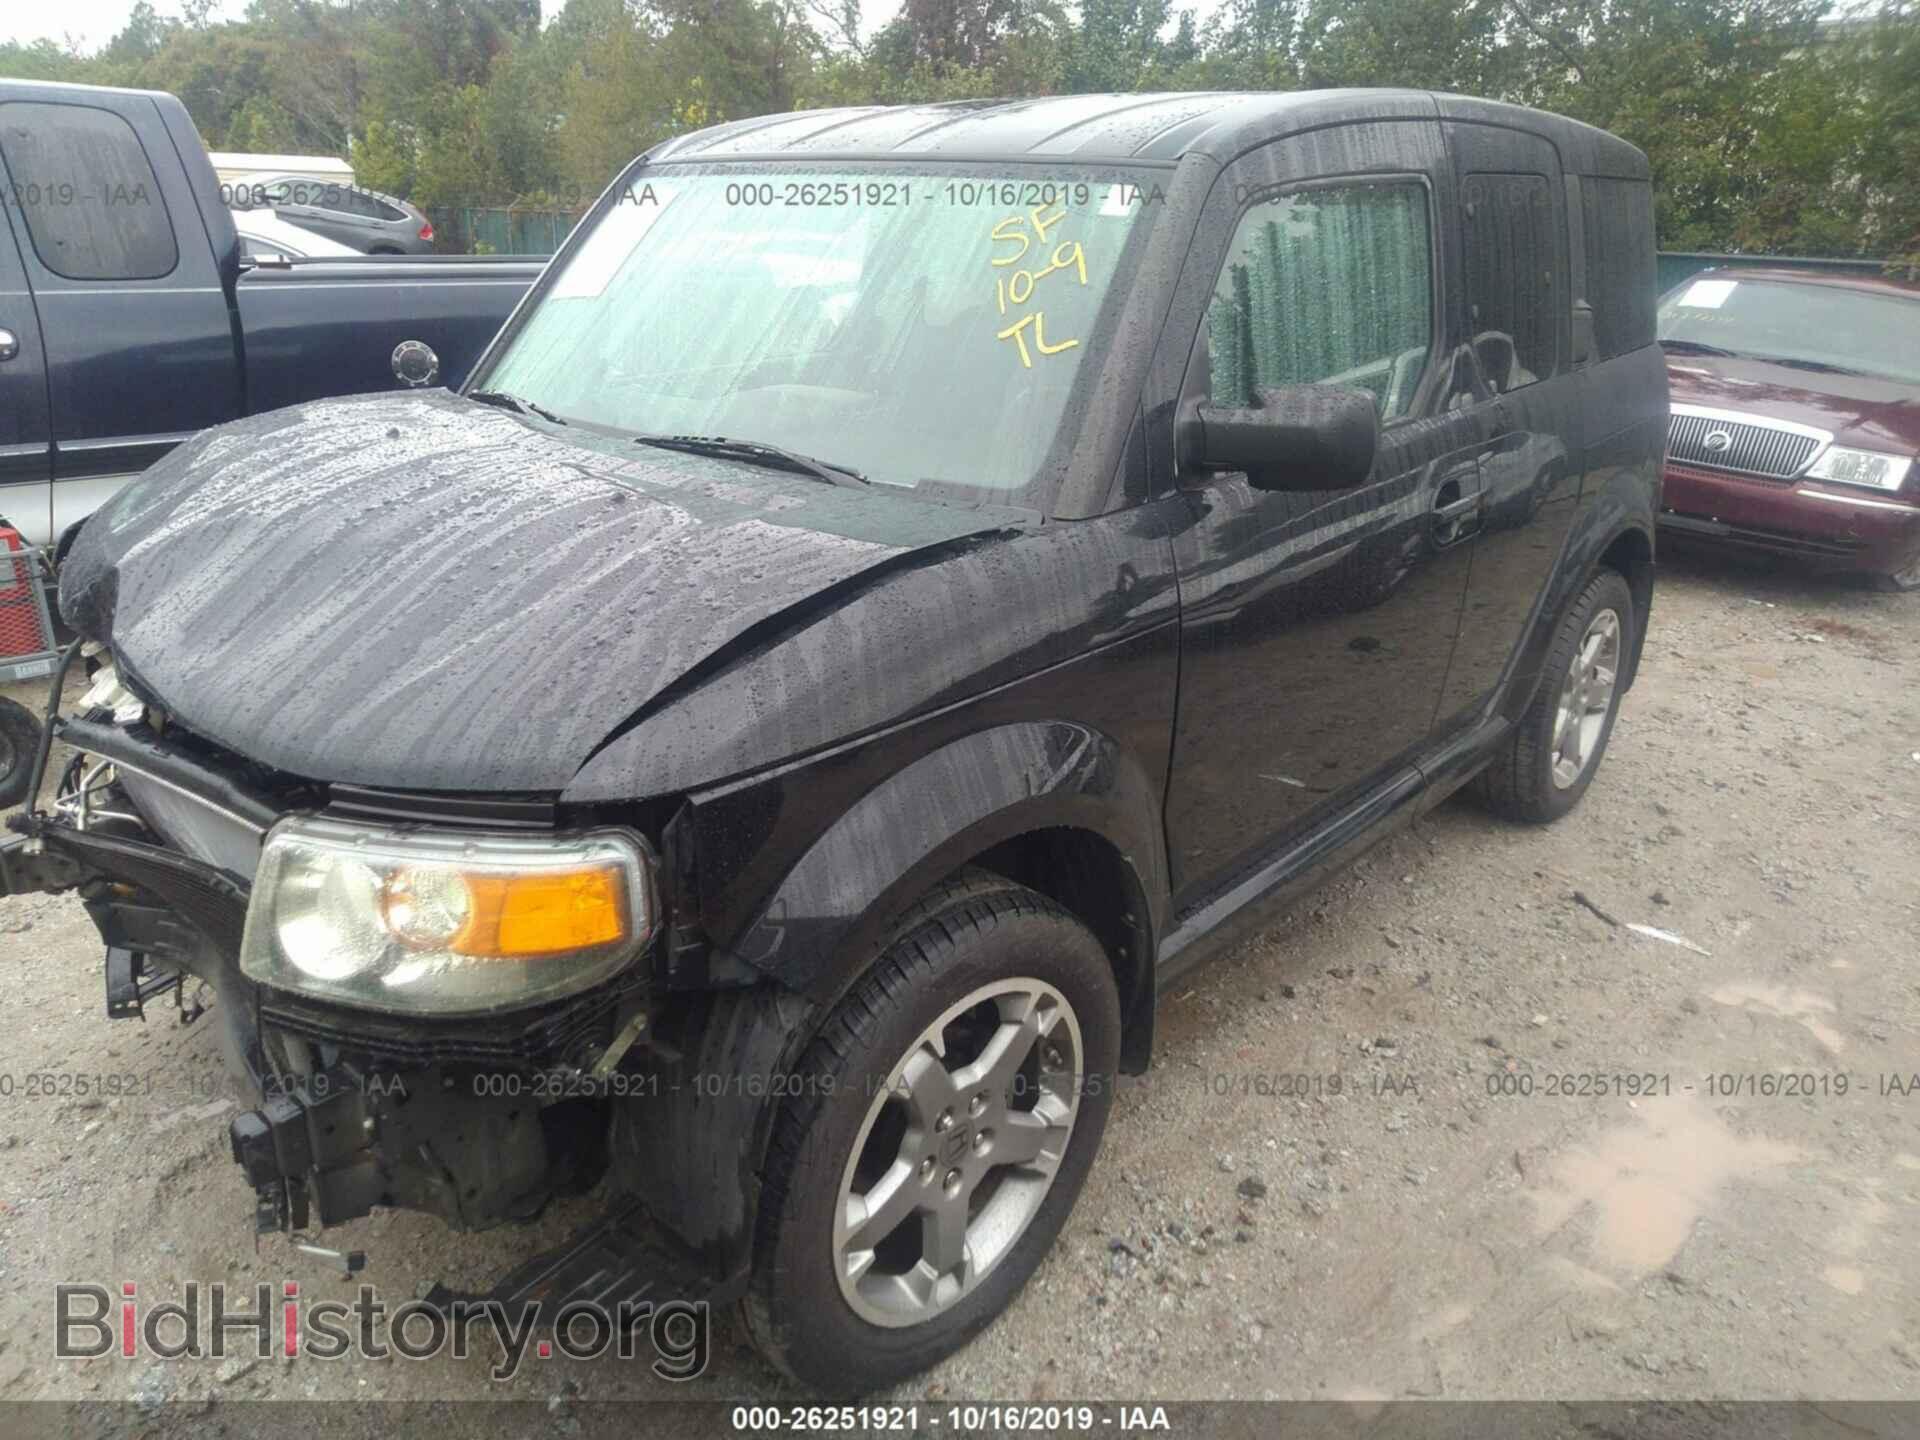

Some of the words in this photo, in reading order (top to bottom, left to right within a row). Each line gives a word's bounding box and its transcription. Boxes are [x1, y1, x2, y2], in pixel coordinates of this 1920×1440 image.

[991, 190, 1067, 266] SF
[999, 241, 1089, 314] 10-9
[997, 311, 1080, 368] TL
